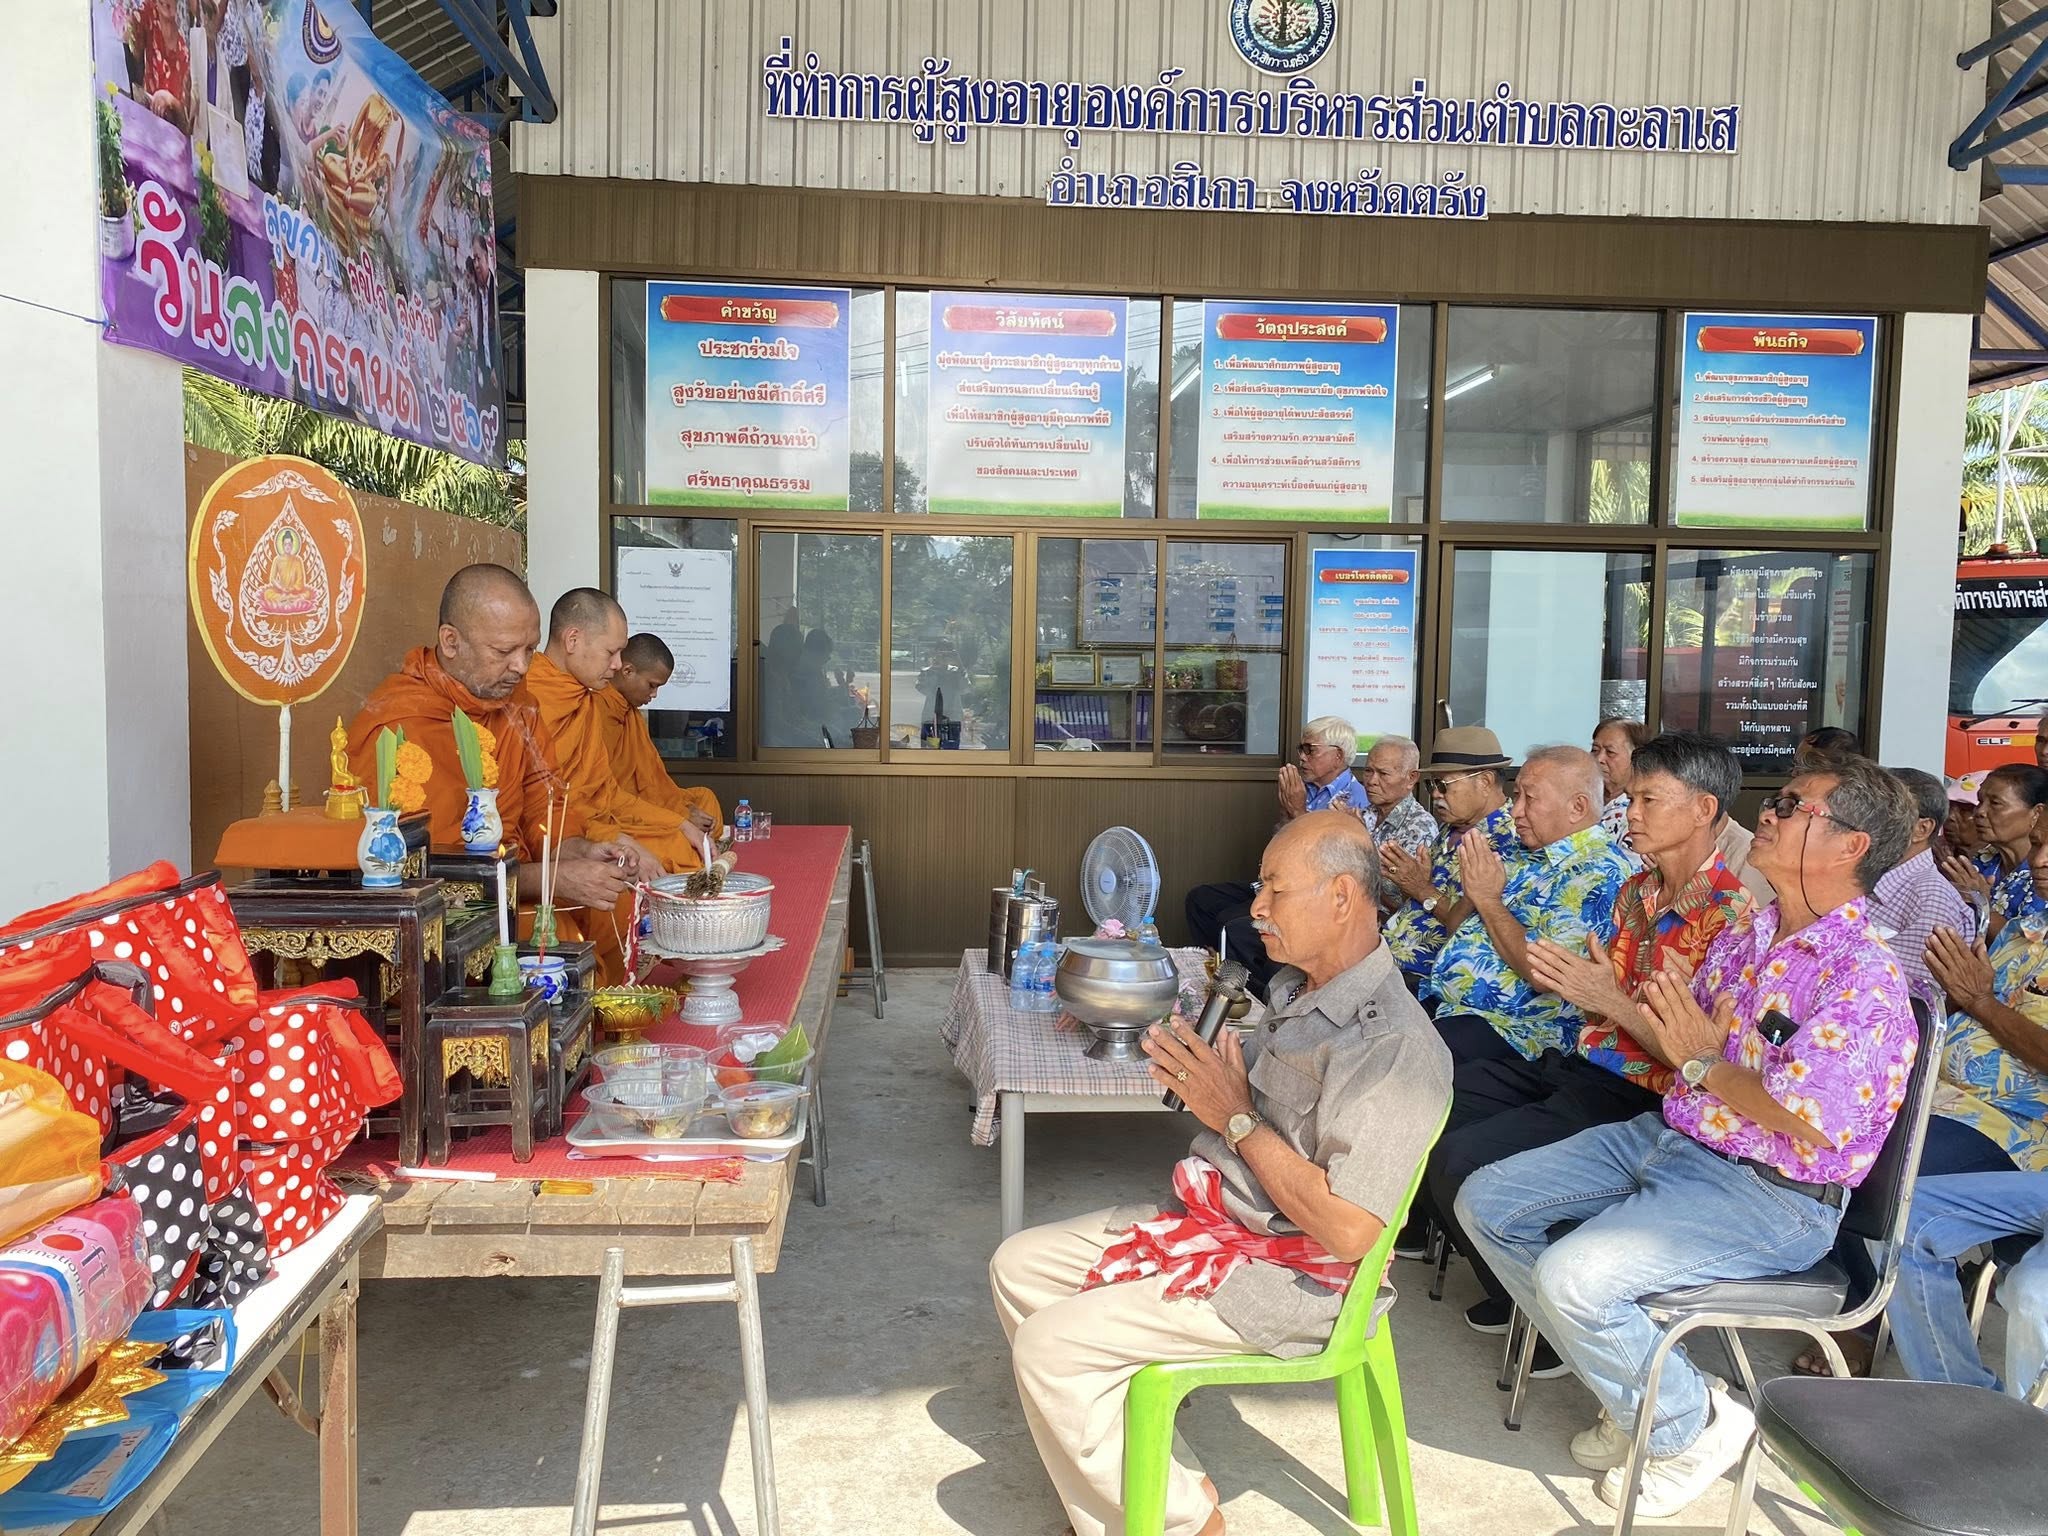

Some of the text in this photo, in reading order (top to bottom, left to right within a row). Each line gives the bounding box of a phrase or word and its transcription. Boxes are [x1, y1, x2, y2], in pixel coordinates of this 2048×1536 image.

[764, 36, 1740, 152] ที่ทำการผู้สูงอายุองค์การบริหารส่วนตำบลกะลาเส
[1049, 156, 1256, 212] อำเภอสิเกา
[134, 180, 421, 432] วันสงกรานต์
[346, 247, 389, 317] สุขใจ
[395, 289, 438, 346] สูงวัย
[721, 300, 777, 323] คำขวัญ
[995, 310, 1065, 329] วิสัยทัศน์
[1256, 318, 1347, 341] วัตถุประสงค์
[1753, 331, 1808, 348] พันธกิจ
[699, 338, 799, 360] ประชาร่วมใจ
[1214, 357, 1339, 374] 1. เพื่อพัฒนาศักยภาพผู้สูงอายุ
[672, 381, 825, 405] สูงวัยอย่างมีศักดิ์ศรี
[958, 381, 1099, 401] ส่งเสริมการแลกเปลี่ยนเรียนรู้
[1213, 381, 1387, 398] 2. เพื่อส่งเสริมสุขภาพอนามัย สุขภาพจิตใจ
[946, 405, 1110, 427] เพื่อให้สมาชิกผู้สูงอายุมีคุณภาพที่ดี
[1212, 409, 1221, 417] 3.
[680, 427, 816, 448] สุขภาพดีถ้วนหน้า
[1223, 431, 1300, 443] เสริมสร้างความรัก
[976, 464, 1077, 478] ของสังคมและประเทศ
[687, 471, 811, 494] ศรัทธาคุณธรรม
[1956, 580, 2048, 610] ค์การบริหารส่
[1738, 655, 1799, 667] มีกิจกรรมร่วมกัน
[1777, 676, 1818, 690] ให้กับสังคม
[1725, 697, 1808, 711] รวมทั้งเป็นแบบอย่างที่ดี
[1977, 737, 2011, 745] ELF
[9, 1247, 86, 1297] ternational
